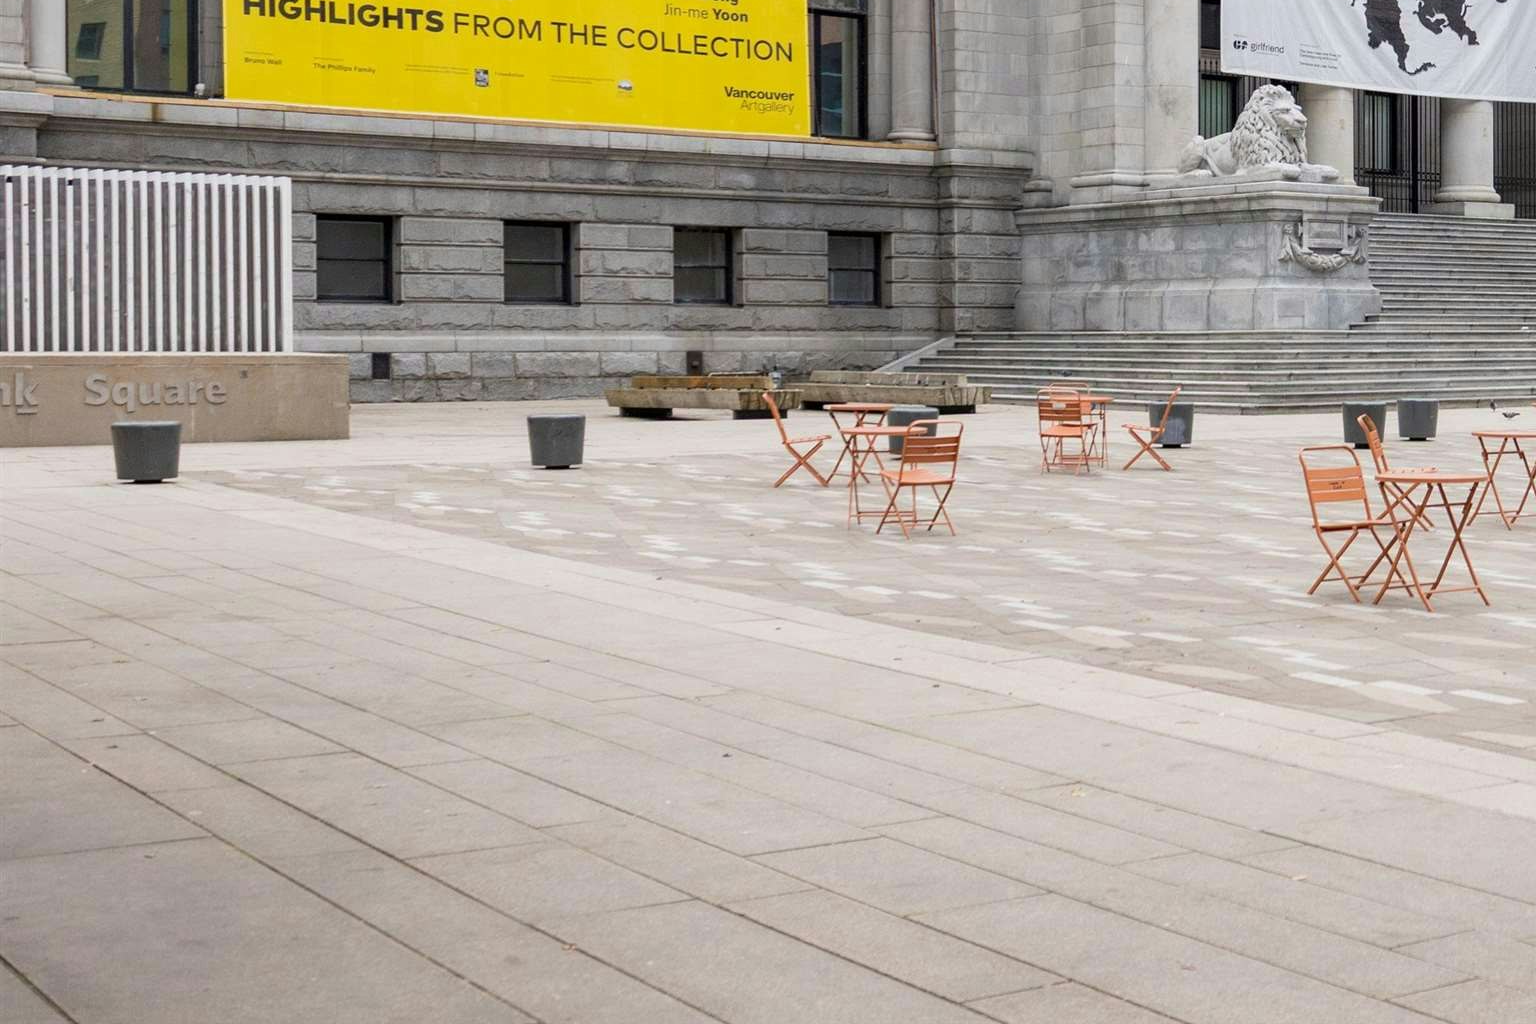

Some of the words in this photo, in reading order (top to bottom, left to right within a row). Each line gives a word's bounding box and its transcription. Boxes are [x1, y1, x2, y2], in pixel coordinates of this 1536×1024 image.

[664, 3, 709, 20] Jin-me
[712, 8, 748, 23] Yoon
[453, 12, 542, 41] FROM
[551, 20, 607, 47] THE
[616, 27, 793, 63] COLLECTION
[1250, 41, 1285, 54] girlfriend
[354, 66, 376, 74] Family
[724, 86, 795, 101] Vancouver
[83, 374, 227, 412] Square
